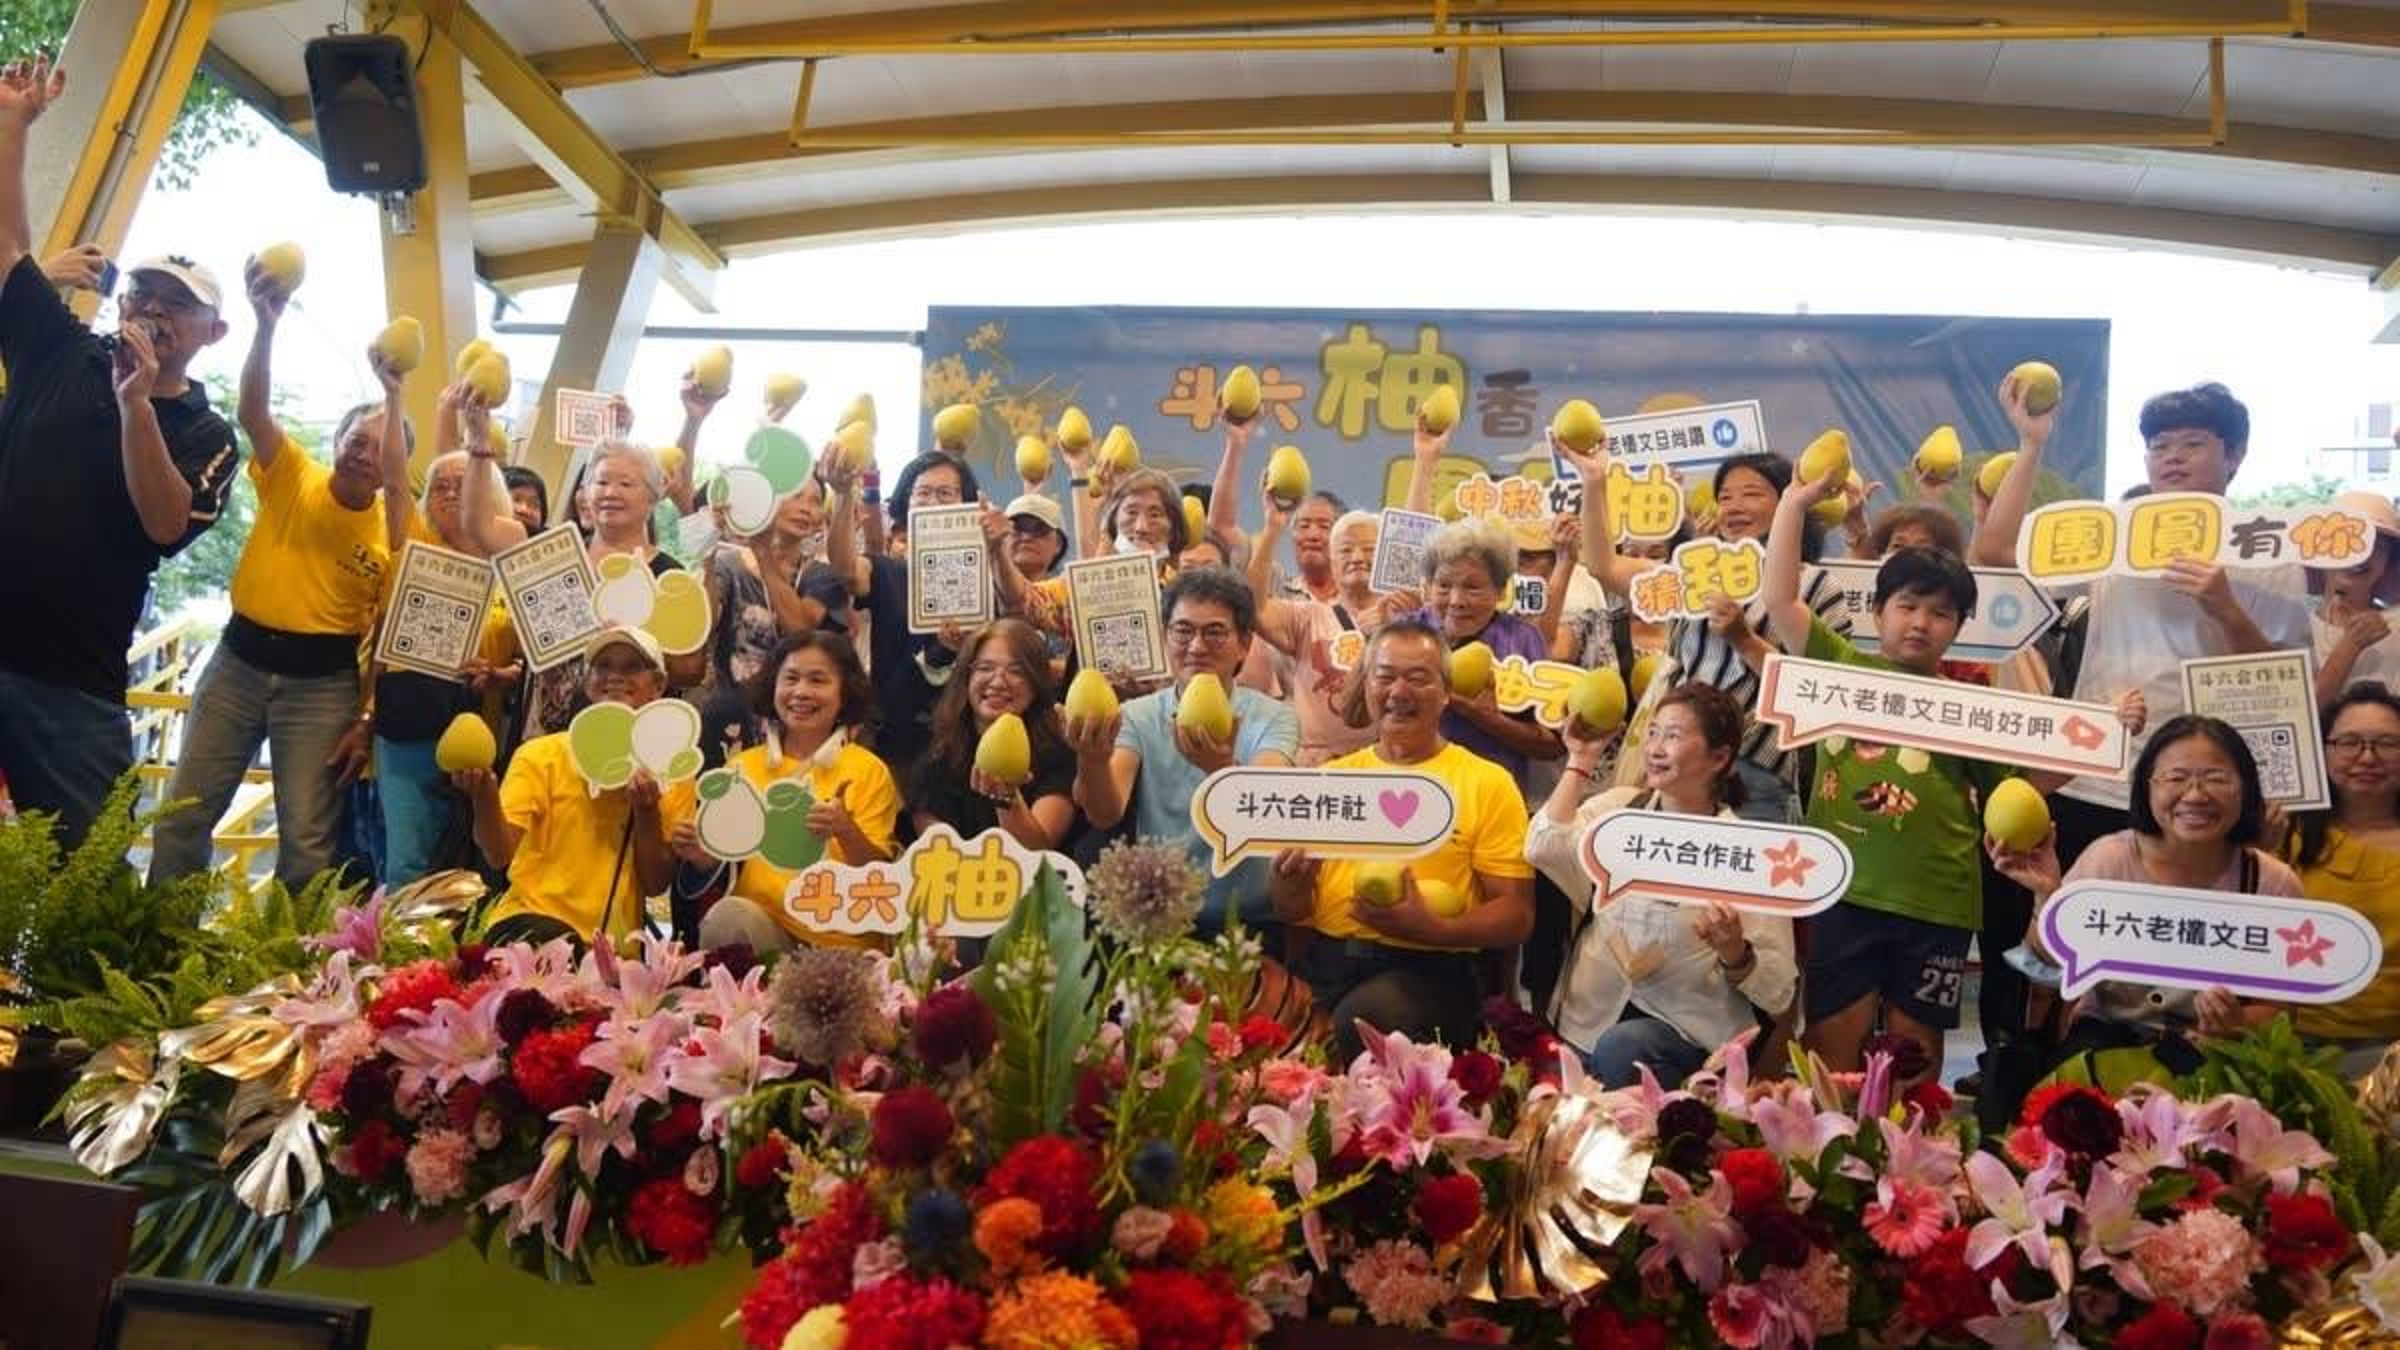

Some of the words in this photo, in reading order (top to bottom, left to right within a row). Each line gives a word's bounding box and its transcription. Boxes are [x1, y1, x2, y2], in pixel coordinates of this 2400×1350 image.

[2029, 497, 2368, 577] 團圓有你
[1236, 791, 1367, 821] 斗六合作社
[1623, 832, 1756, 872] 斗六合作社
[792, 834, 1075, 928] 斗六柚
[1915, 967, 1960, 1007] 23
